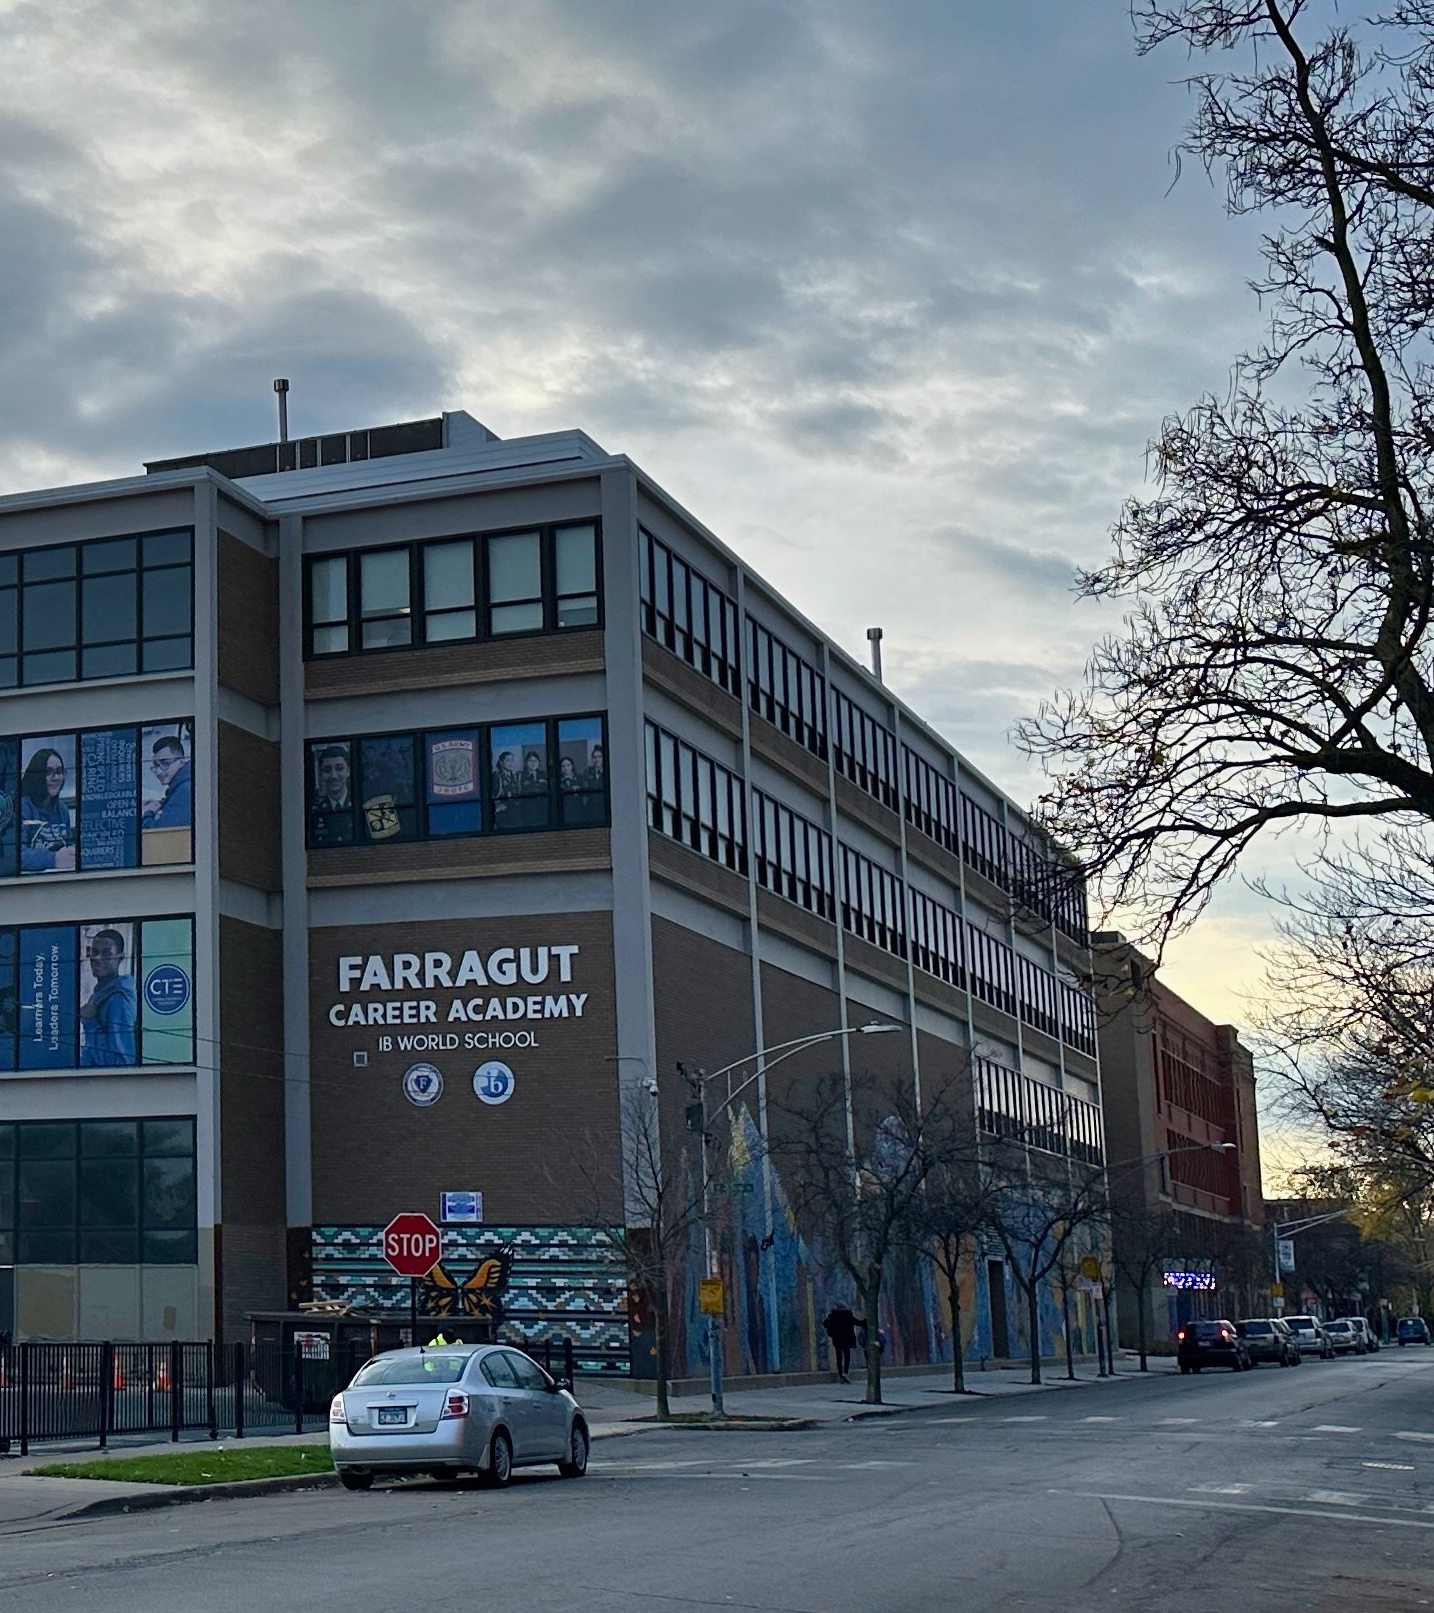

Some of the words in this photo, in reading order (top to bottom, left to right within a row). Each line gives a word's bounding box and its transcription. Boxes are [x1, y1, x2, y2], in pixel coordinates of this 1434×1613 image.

[339, 945, 580, 992] FARRAGUT
[150, 978, 183, 995] CTE
[32, 992, 43, 1042] Learners
[329, 1000, 437, 1027] CAREER
[447, 993, 589, 1023] ACADEMY
[49, 1004, 59, 1051] Leaders
[378, 1036, 393, 1052] IB
[397, 1034, 459, 1051] WORLD
[464, 1031, 540, 1049] SCHOOL
[419, 1077, 427, 1091] F
[387, 1233, 437, 1257] STOP
